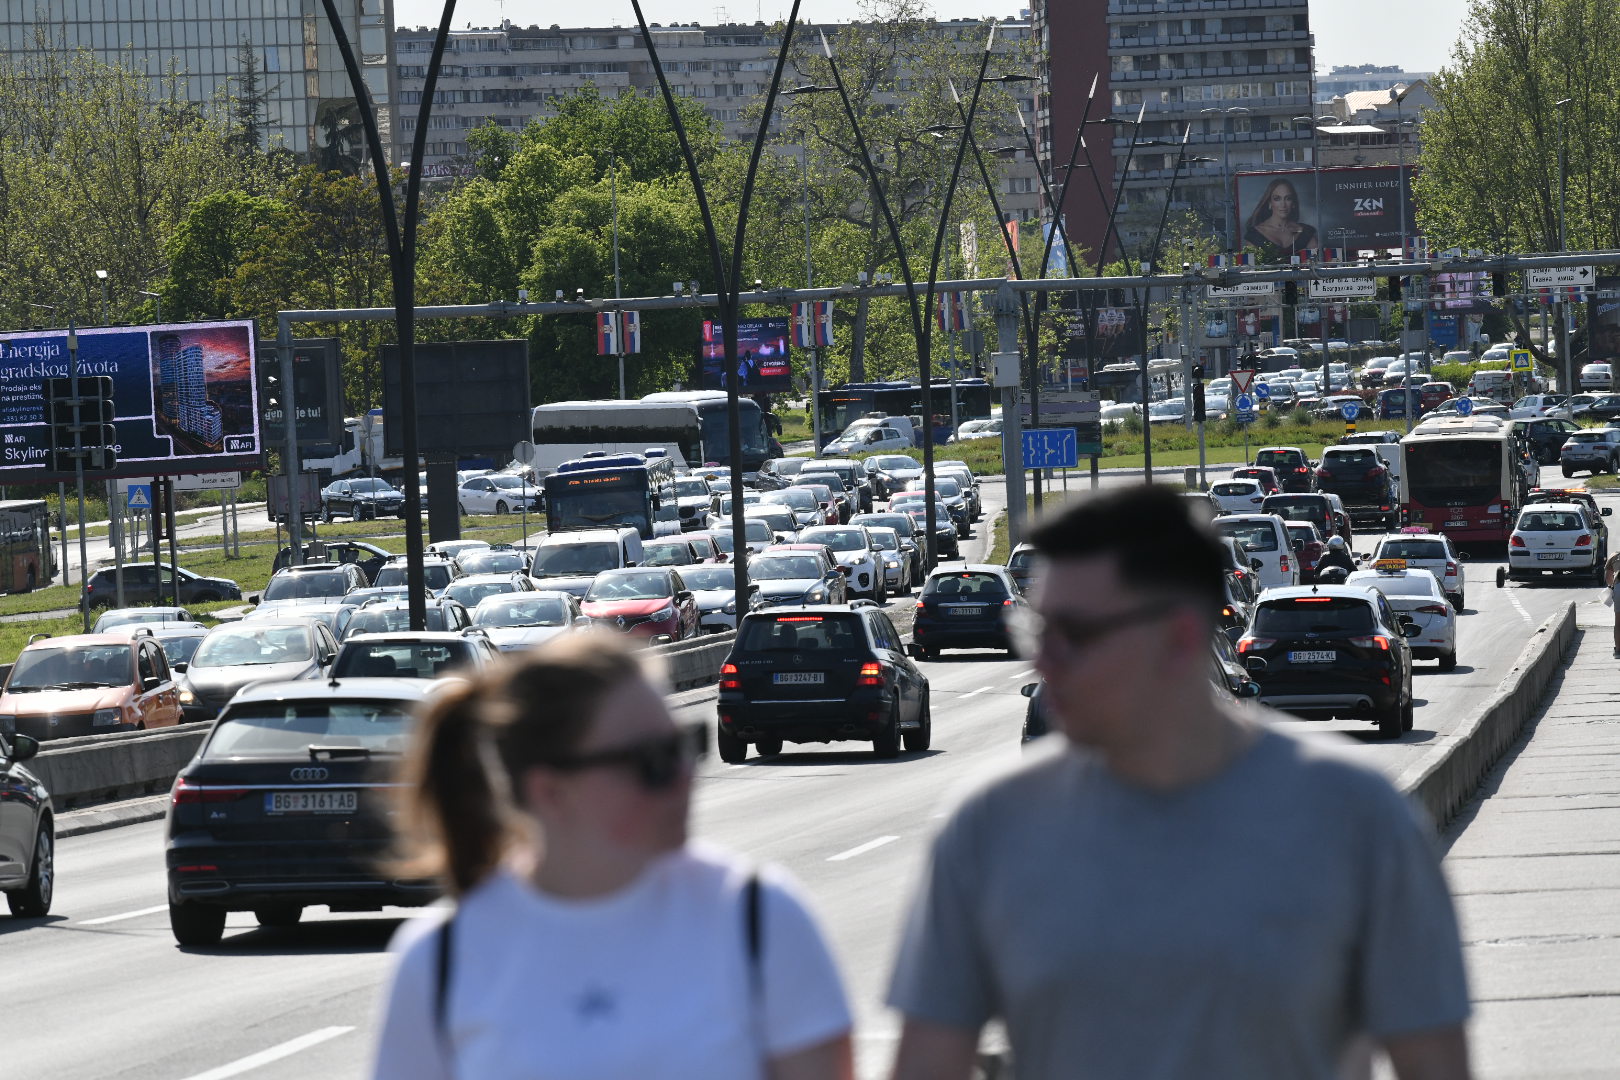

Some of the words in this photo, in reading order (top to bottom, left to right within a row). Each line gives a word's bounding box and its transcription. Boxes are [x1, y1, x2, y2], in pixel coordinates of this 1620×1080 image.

[1335, 180, 1373, 191] JENNIFER
[1375, 180, 1400, 188] LOPEZ
[1353, 197, 1383, 210] ZEN
[0, 362, 69, 382] gradskog
[0, 384, 28, 393] Prodaja
[308, 406, 321, 418] tu!
[14, 435, 26, 443] AFI
[240, 441, 252, 449] AFI
[1293, 652, 1303, 660] BG
[779, 673, 789, 682] BG
[274, 793, 292, 809] BG
[300, 792, 355, 809] 3161-AB
